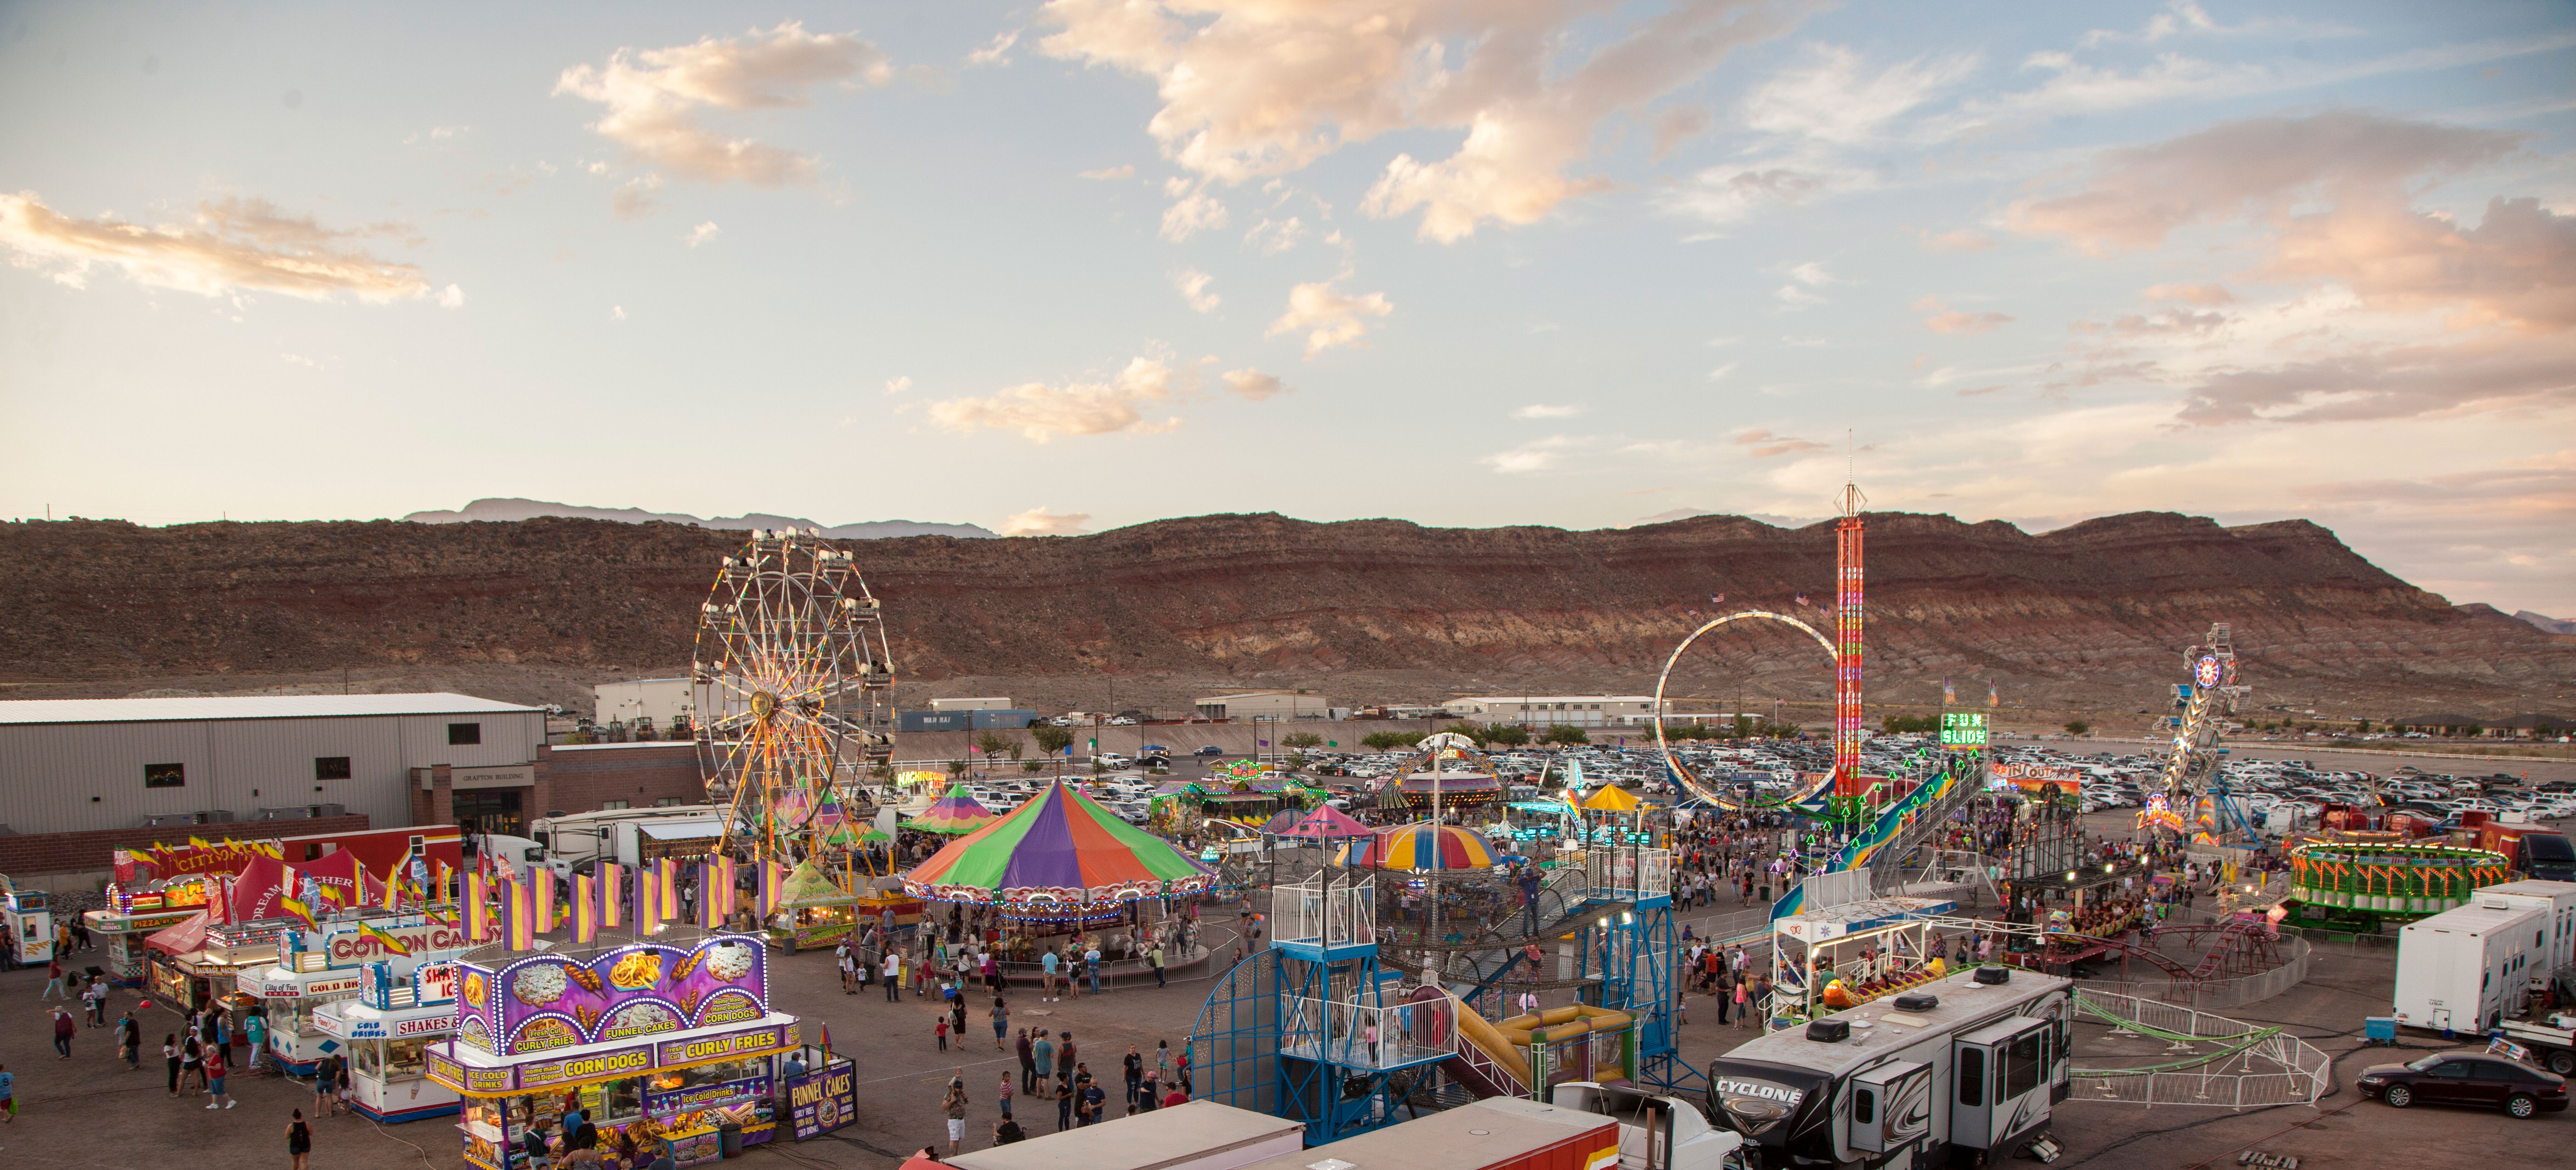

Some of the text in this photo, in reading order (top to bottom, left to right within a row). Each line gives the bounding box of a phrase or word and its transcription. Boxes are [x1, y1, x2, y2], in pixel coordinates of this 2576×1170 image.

[1948, 713, 1982, 727] FUN
[1943, 730, 1985, 744] SLIDE
[2029, 768, 2051, 777] OUT
[179, 853, 214, 871] CITY
[188, 884, 205, 896] PIZ
[252, 884, 283, 920] DREAM
[133, 919, 160, 928] PIZZA
[333, 934, 426, 959] COTON
[311, 982, 340, 992] COLD
[442, 982, 455, 998] IC
[727, 1002, 745, 1010] Dipped
[705, 1009, 755, 1024] CORN DOGS
[400, 1017, 447, 1034] SHAKES
[605, 1021, 676, 1039] FUNNEL CAKES
[465, 1032, 491, 1048] FUNNEL CAKES
[530, 1029, 548, 1038] Fresh
[791, 1033, 800, 1042] DRI
[516, 1035, 575, 1052] CURLY FRIES
[666, 1045, 683, 1053] Fresh
[686, 1032, 776, 1058] CURLY FRIES
[437, 1059, 450, 1077] CURLY
[451, 1066, 464, 1083] FRIES
[565, 1052, 647, 1076] CORN DOGS
[3, 1078, 9, 1086] 9
[541, 1072, 562, 1081] Dipped
[683, 1088, 734, 1104] Ice Cold Drinks
[792, 1073, 850, 1107] FUNNEL CAKES
[1716, 1080, 1803, 1104] CYCLONE
[841, 1094, 852, 1104] NACHOS
[795, 1106, 814, 1118] CURLY FRIES
[840, 1103, 853, 1114] CHURROS
[796, 1116, 814, 1128] CORN DOGS
[807, 1125, 819, 1135] DRINKS
[673, 1133, 718, 1150] FUNNEL CAKES
[675, 1153, 719, 1169] FRIED DOUGH
